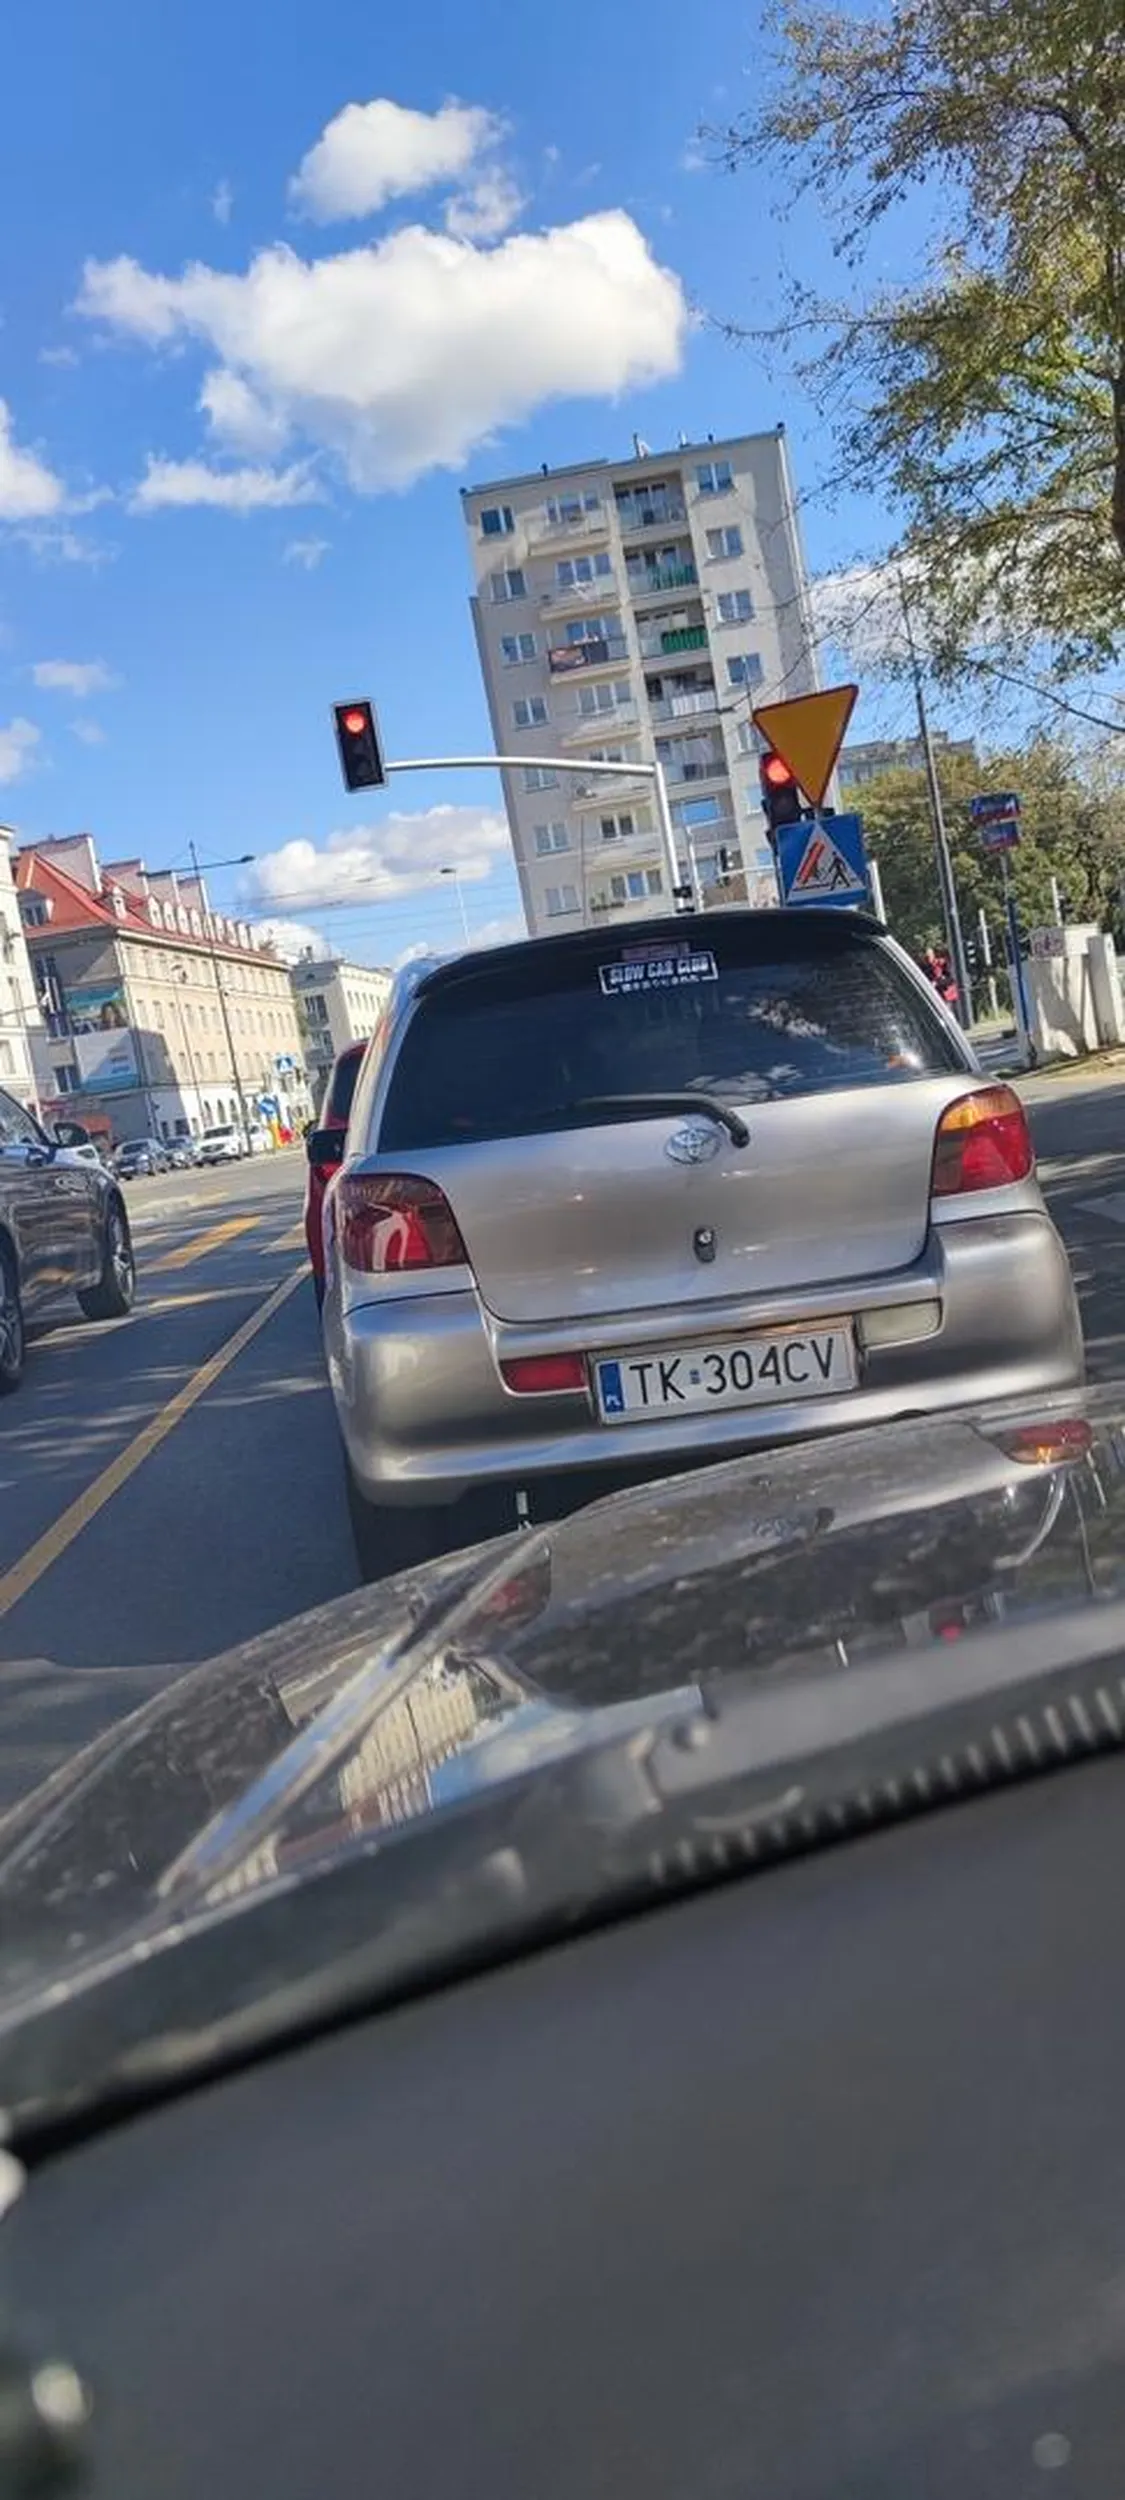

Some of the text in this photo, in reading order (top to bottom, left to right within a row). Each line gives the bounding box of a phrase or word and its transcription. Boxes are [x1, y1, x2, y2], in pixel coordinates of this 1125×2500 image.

[609, 965, 645, 985] SLOW
[647, 961, 674, 978] CAR
[677, 955, 709, 974] CLUB
[629, 1337, 834, 1405] TK 304CV
[606, 1394, 621, 1407] PL
